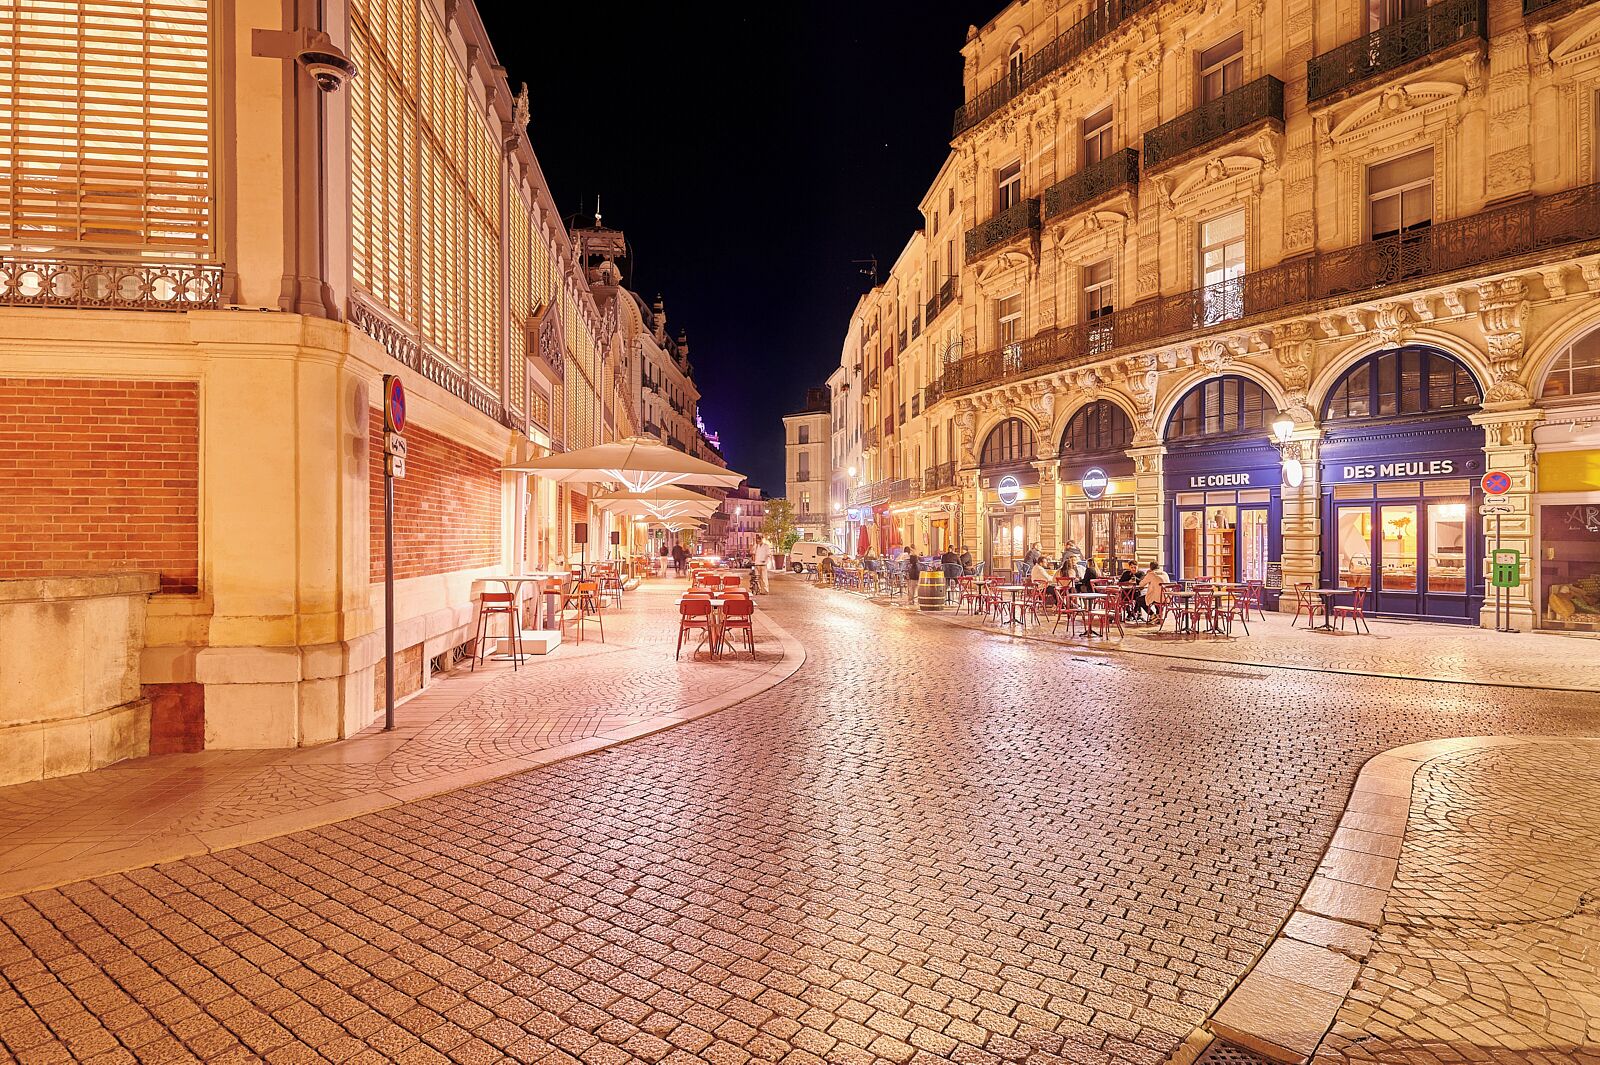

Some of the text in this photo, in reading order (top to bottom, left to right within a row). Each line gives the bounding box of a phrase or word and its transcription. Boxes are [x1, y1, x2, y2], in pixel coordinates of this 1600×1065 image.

[1343, 460, 1453, 479] DES MEULES
[1190, 473, 1250, 488] LE COEUR
